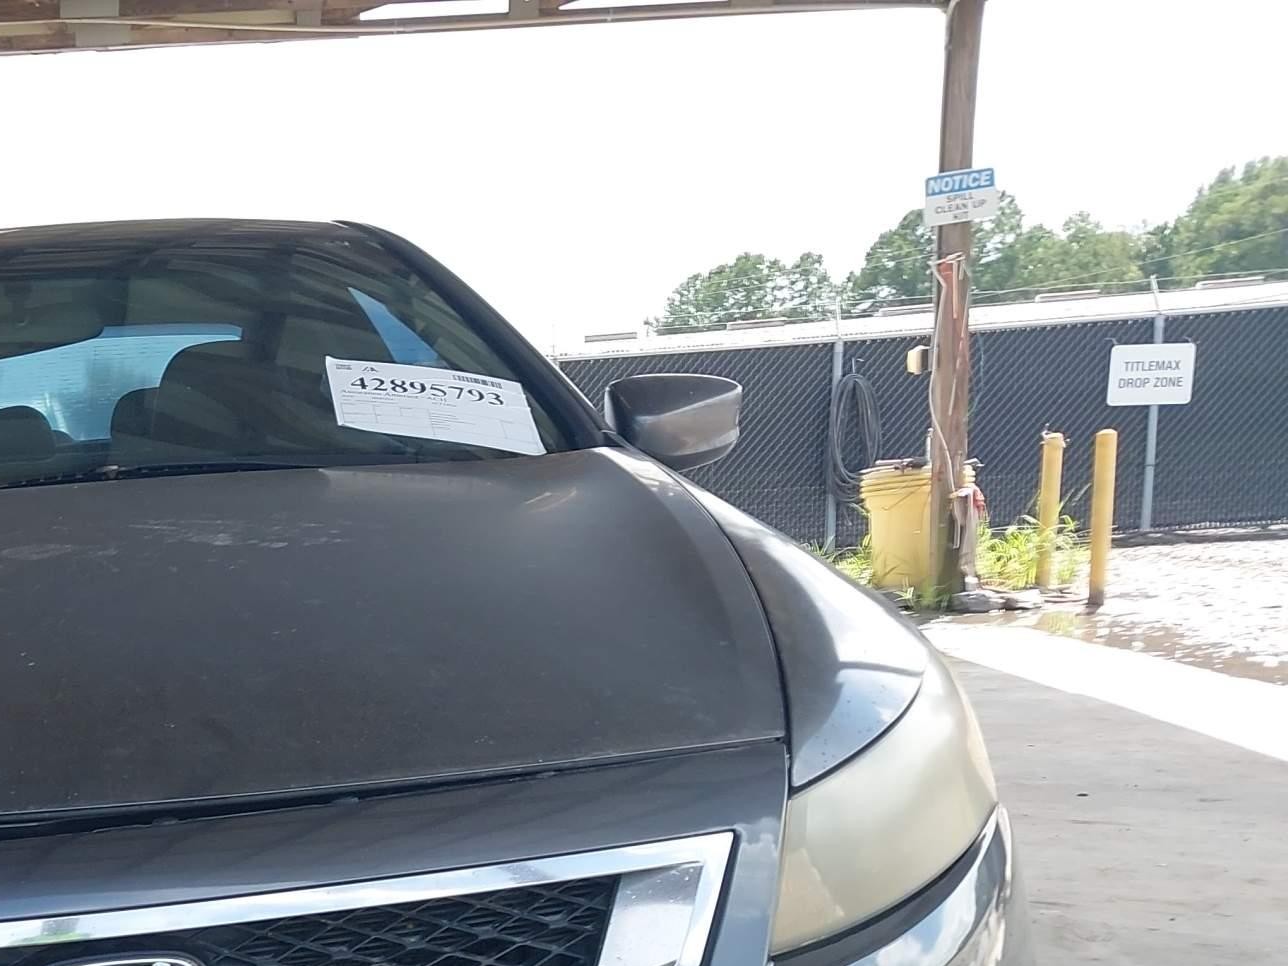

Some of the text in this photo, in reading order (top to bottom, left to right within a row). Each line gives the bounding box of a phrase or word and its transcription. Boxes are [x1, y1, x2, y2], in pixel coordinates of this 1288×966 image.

[927, 170, 992, 195] NOTICE
[946, 192, 974, 203] SPILL
[935, 202, 968, 214] CLEAN
[1124, 360, 1181, 372] TITLEMAX
[1118, 376, 1184, 389] DROP ZONE
[350, 376, 505, 406] 42895793
